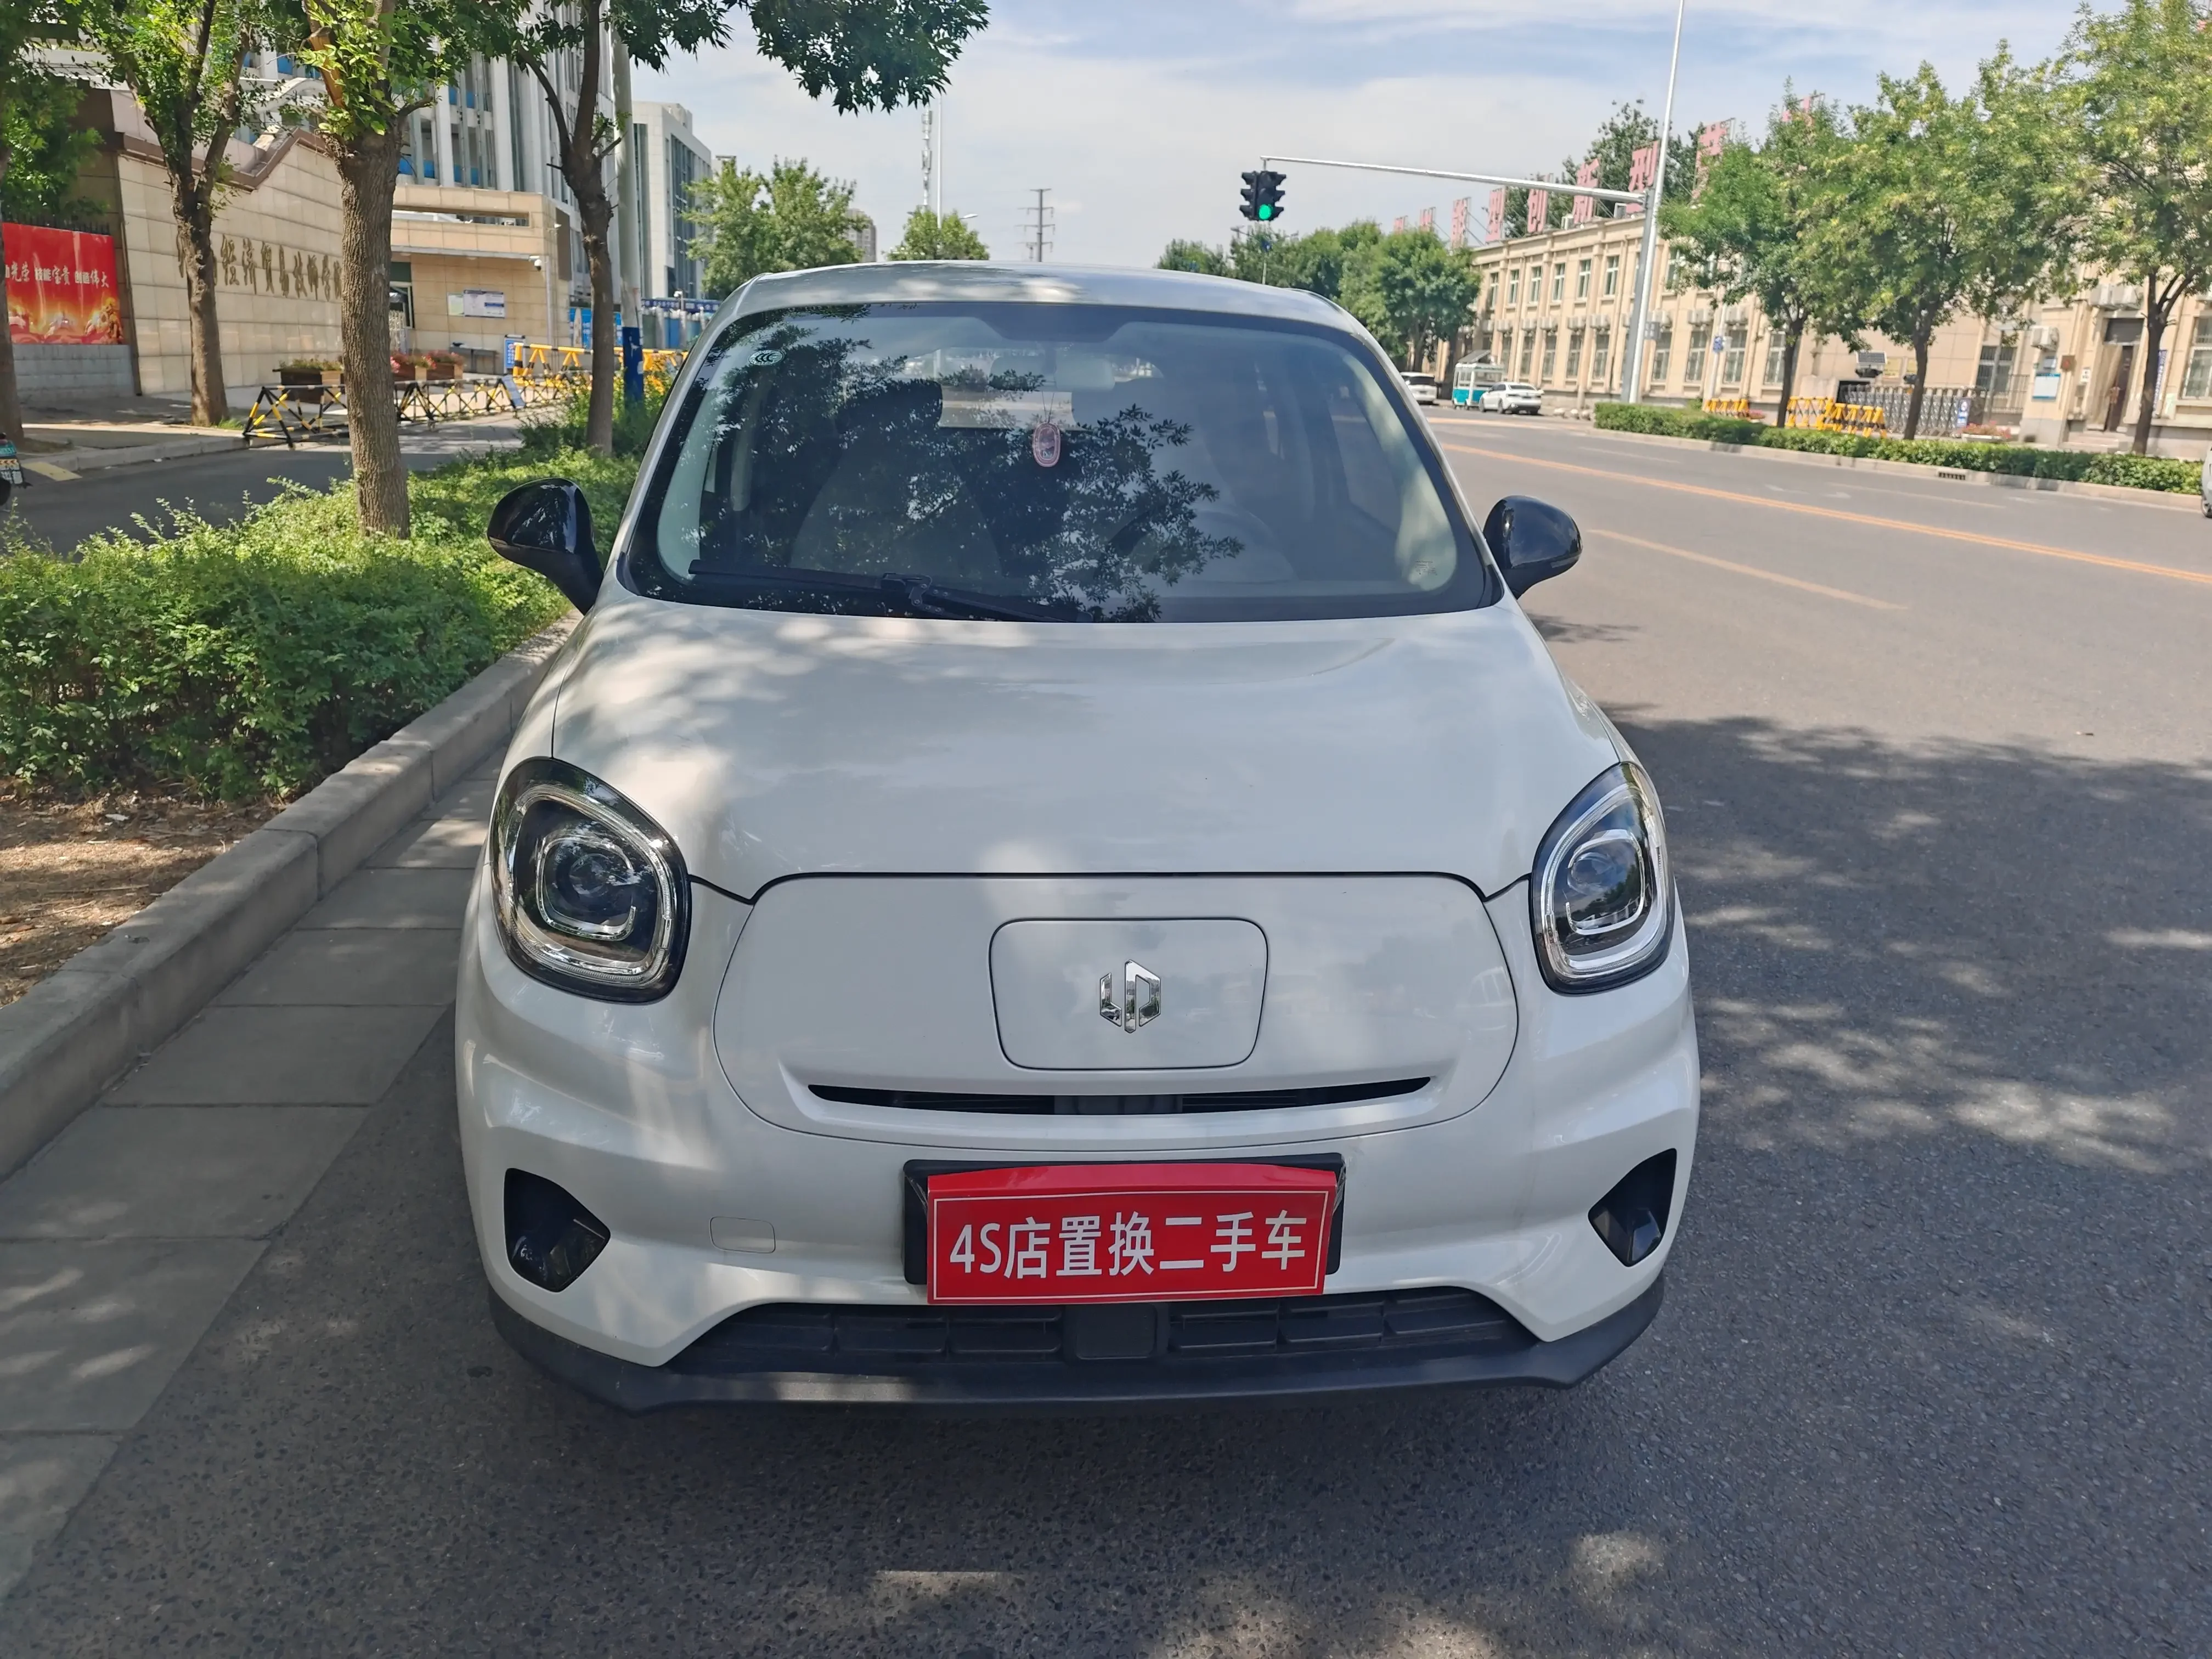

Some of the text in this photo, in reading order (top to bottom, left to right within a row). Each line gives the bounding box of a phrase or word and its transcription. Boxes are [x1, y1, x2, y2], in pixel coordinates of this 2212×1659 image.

[949, 1209, 1307, 1279] 4S店置换二手车
